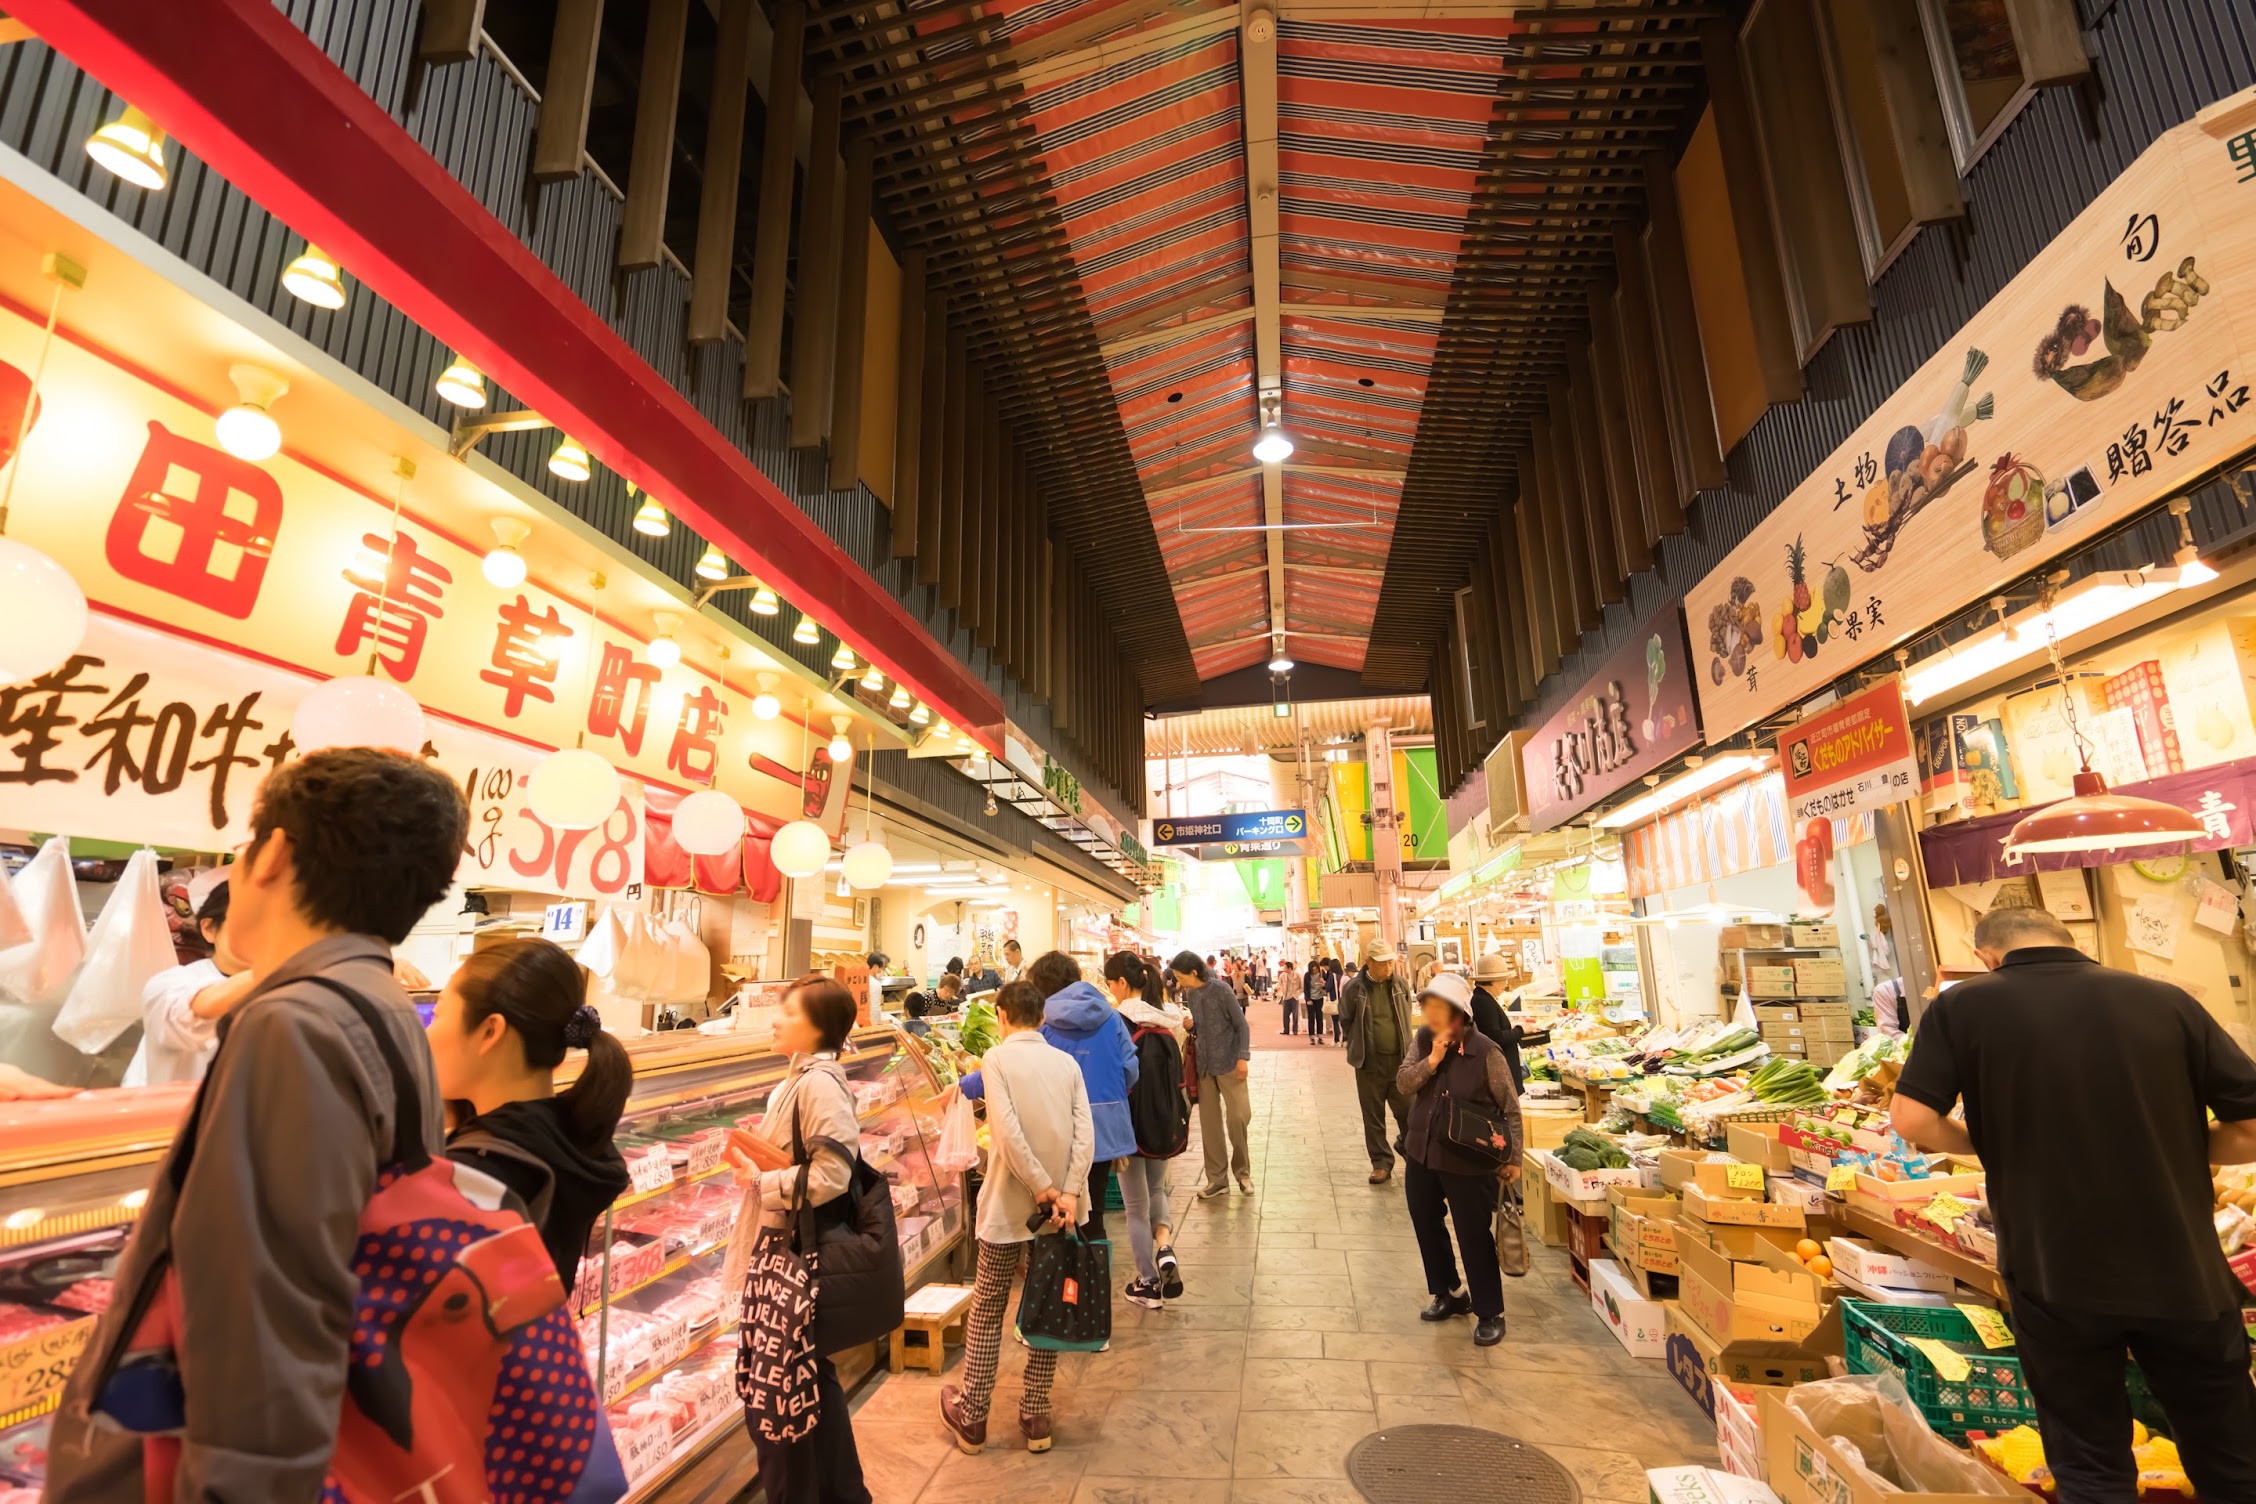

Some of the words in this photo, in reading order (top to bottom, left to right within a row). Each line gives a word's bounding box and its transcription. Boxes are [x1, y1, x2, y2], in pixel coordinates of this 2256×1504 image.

[2119, 212, 2160, 262] 旬
[2107, 369, 2251, 486] 贈答品
[1832, 451, 1879, 511] 土物
[1844, 596, 1885, 642] 果実
[1813, 717, 1894, 772] くだものアドバイザー
[1803, 787, 1855, 818] くだものはかせ
[1176, 824, 1222, 837] 市姫神社口
[1236, 825, 1284, 836] パーキング口
[1403, 833, 1419, 847] 20
[1642, 1233, 1672, 1245] とちおとめ
[1643, 1258, 1673, 1269] とちおとめ
[1866, 1264, 1888, 1275] 沖縄
[1673, 1342, 1709, 1411] レタス
